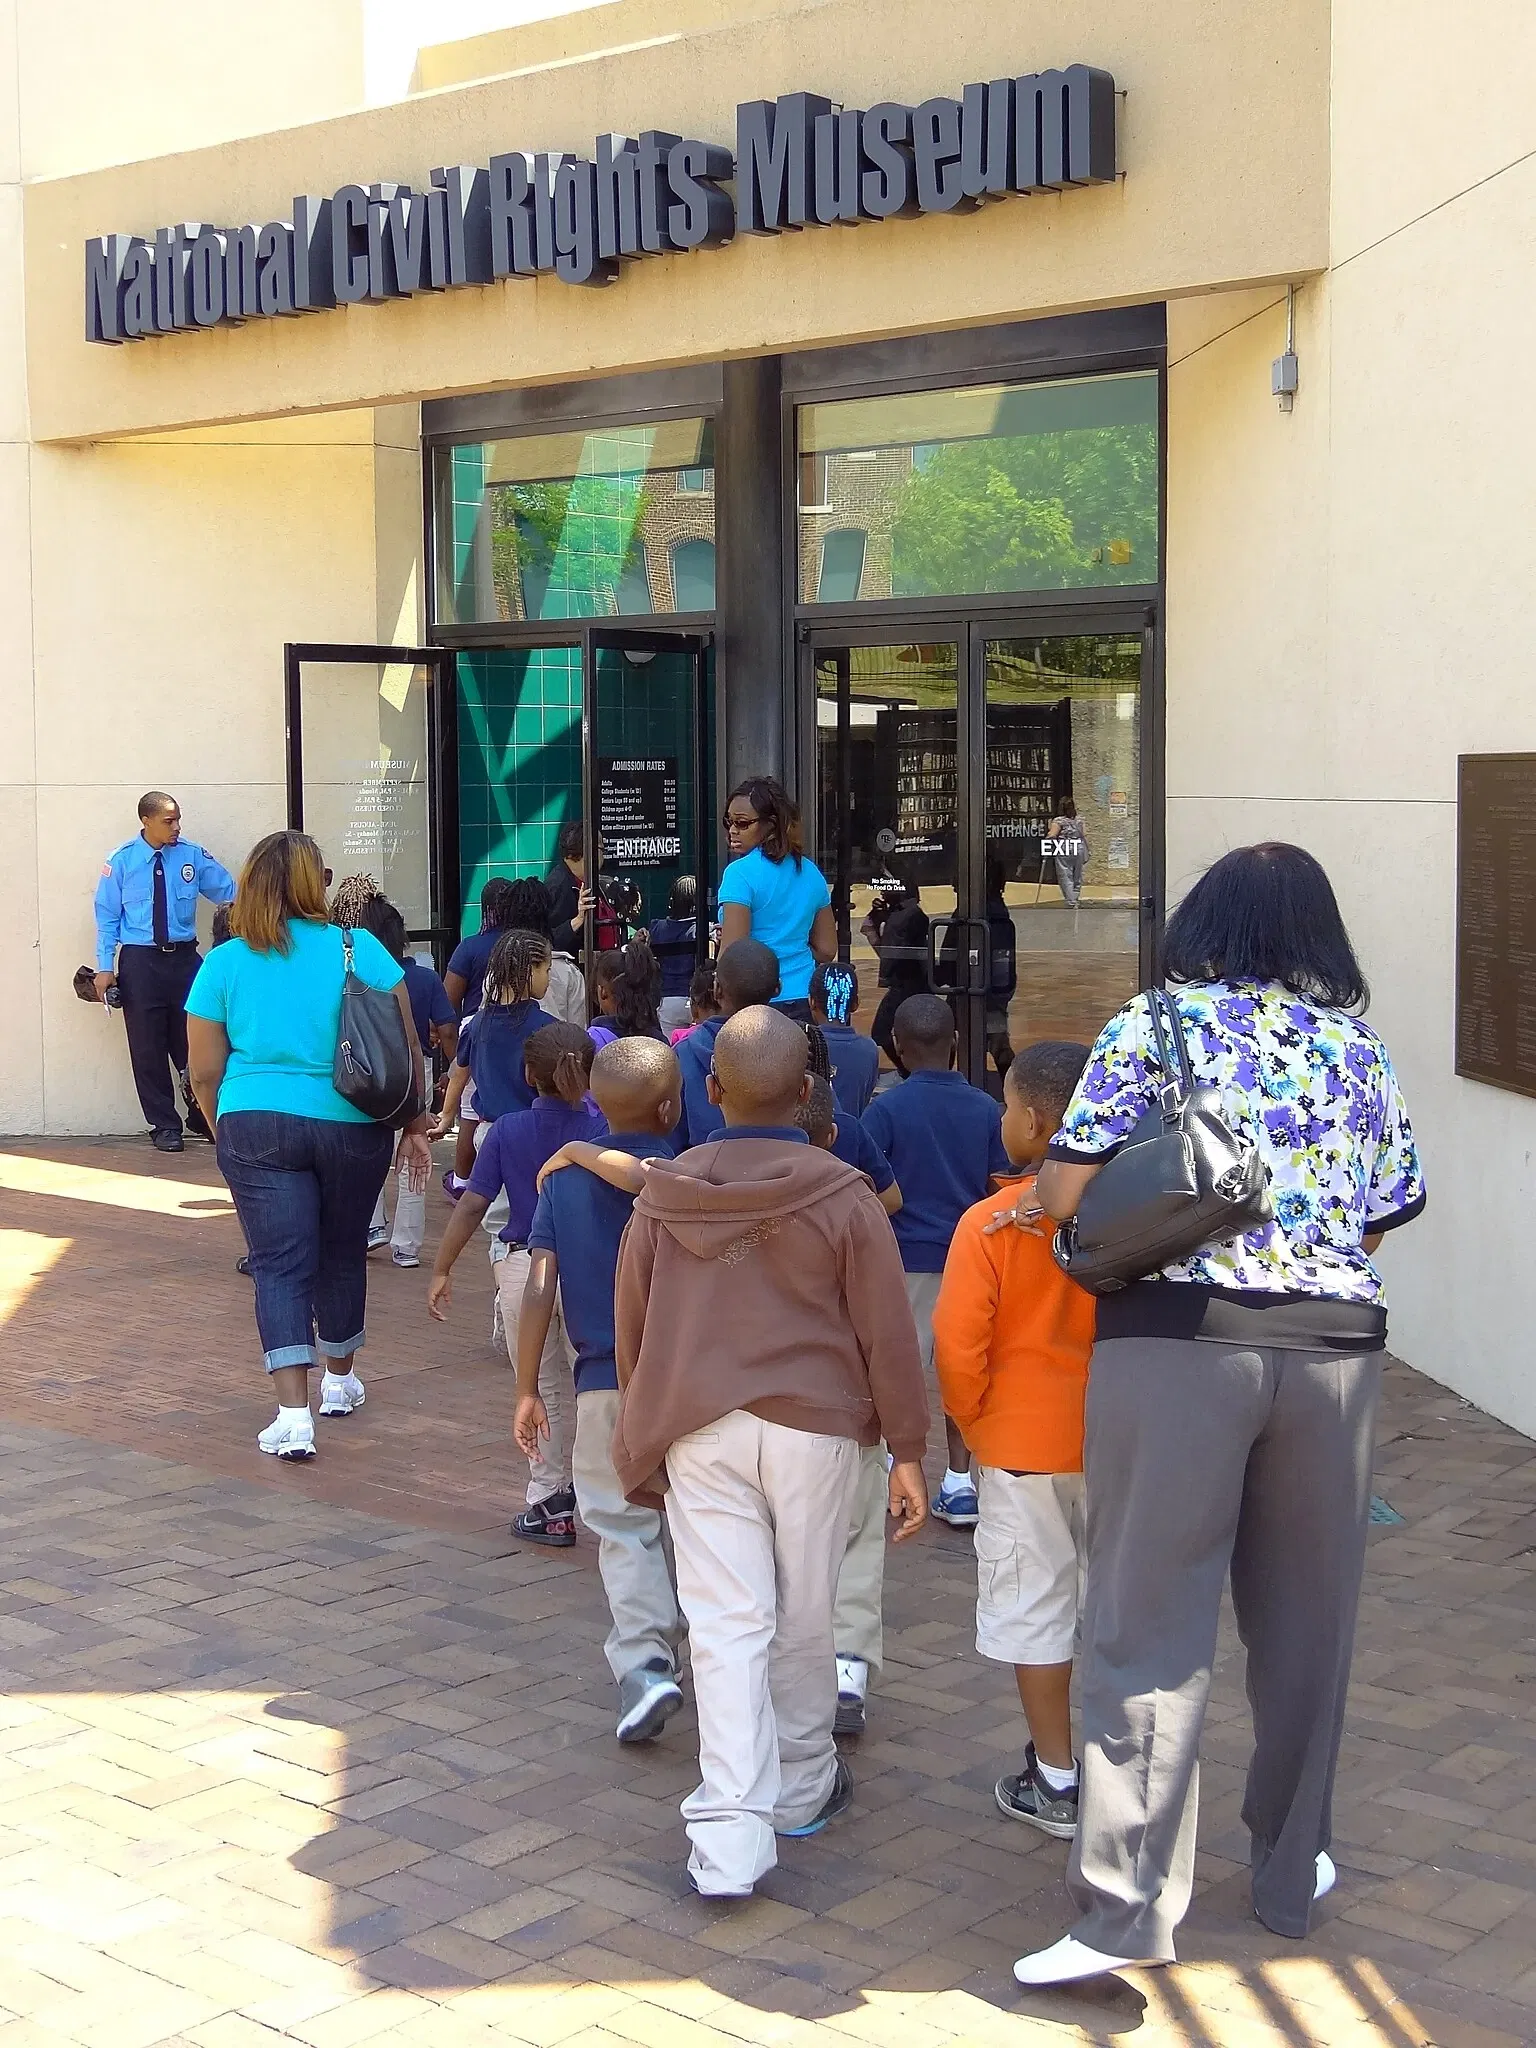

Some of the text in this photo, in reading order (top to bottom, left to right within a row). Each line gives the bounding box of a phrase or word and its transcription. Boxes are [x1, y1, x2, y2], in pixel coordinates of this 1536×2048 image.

[85, 63, 1108, 346] National Civil Rights Museum
[612, 760, 666, 771] ADMISSION RATES
[986, 824, 1045, 838] ENTRANCE
[616, 837, 681, 856] ENTRANCE
[1040, 840, 1082, 856] EXIT
